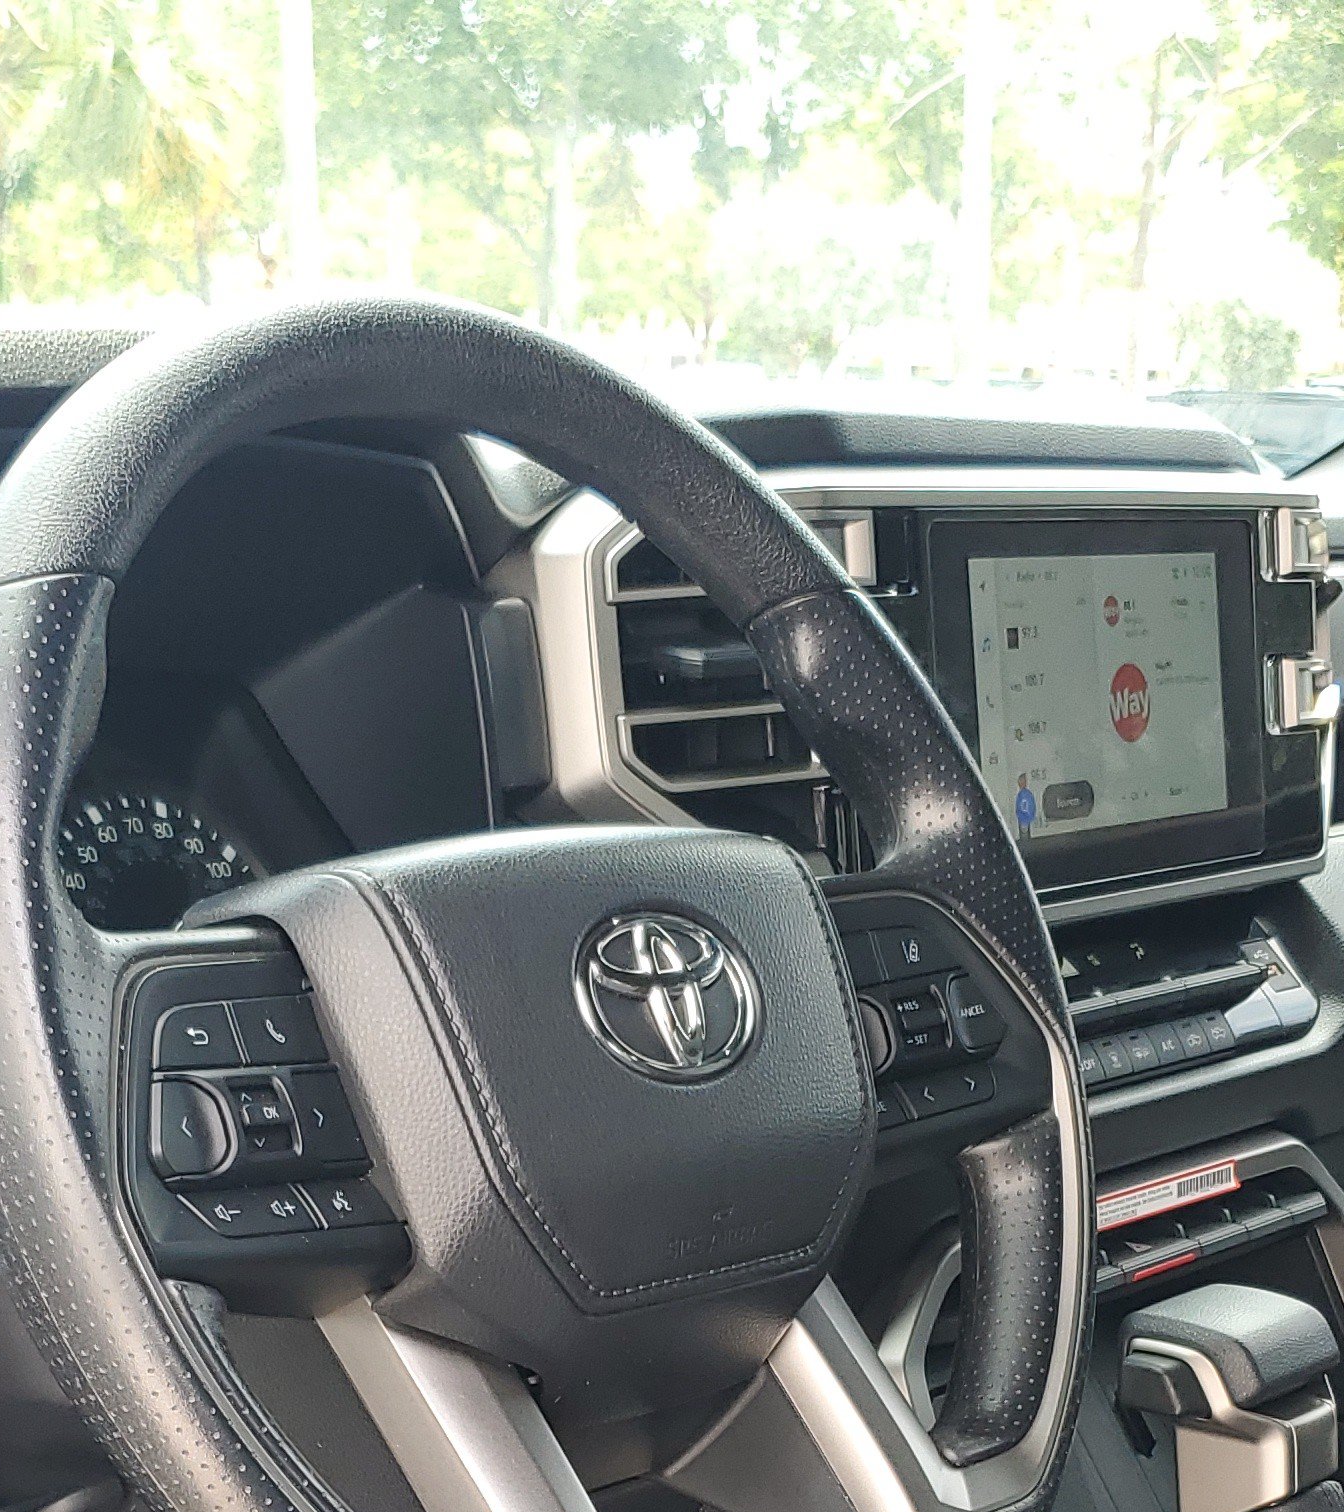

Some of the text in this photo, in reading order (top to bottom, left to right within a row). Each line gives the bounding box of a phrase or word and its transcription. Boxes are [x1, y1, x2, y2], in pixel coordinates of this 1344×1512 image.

[123, 817, 144, 834] 70
[152, 822, 174, 839] 80
[97, 826, 118, 843] 60
[183, 837, 205, 855] 90
[77, 846, 98, 864] 50
[205, 861, 232, 878] 100
[65, 874, 87, 891] 40
[262, 1106, 280, 1120] OK
